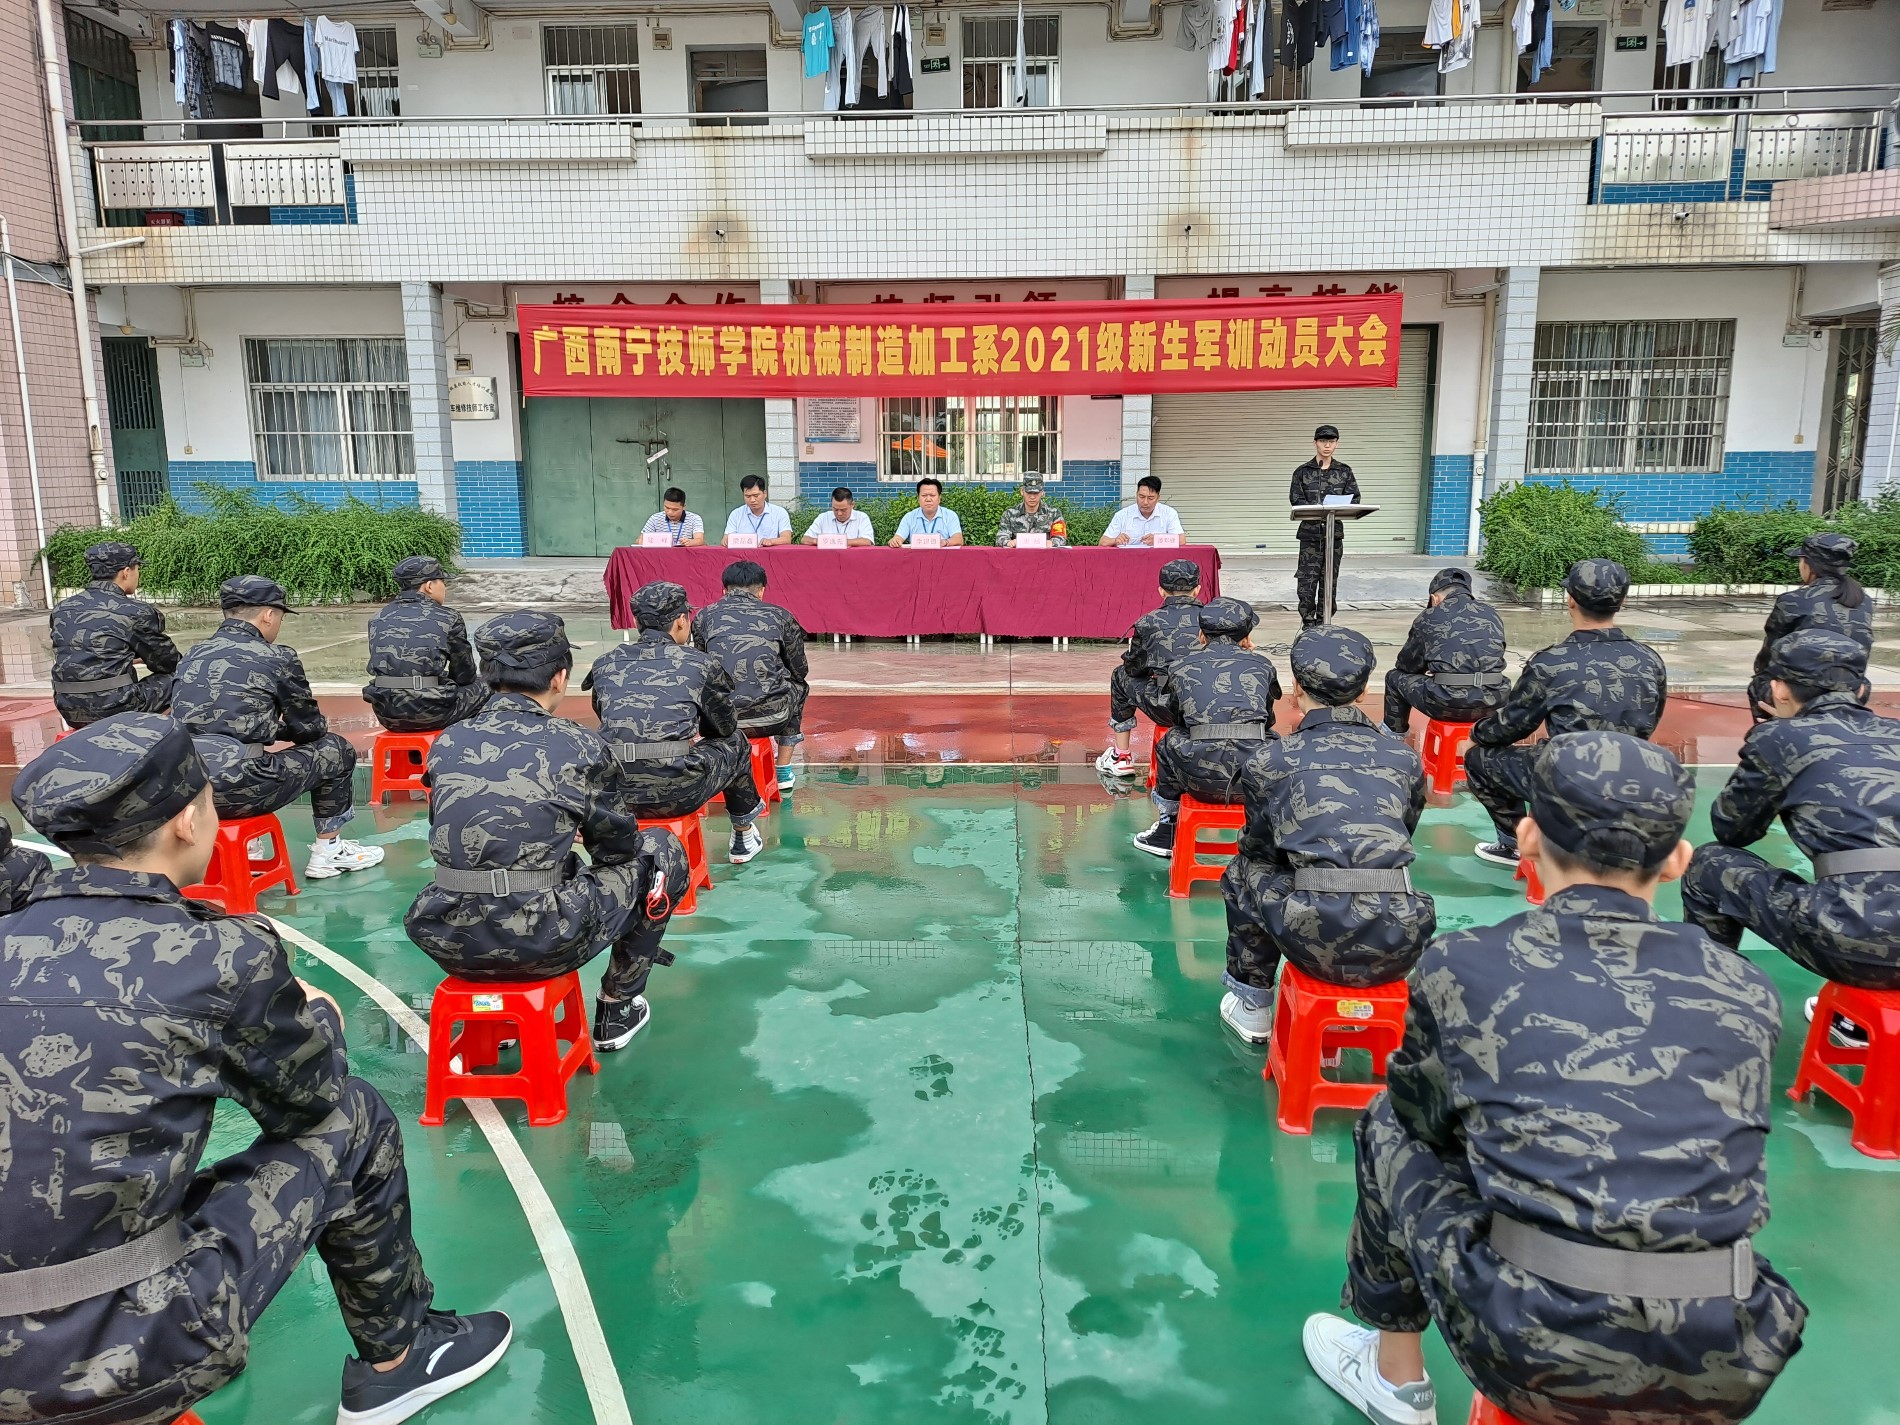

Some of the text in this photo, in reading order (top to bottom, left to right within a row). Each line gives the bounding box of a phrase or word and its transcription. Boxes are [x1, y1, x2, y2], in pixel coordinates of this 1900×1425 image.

[533, 314, 1388, 376] 广西南宁技师学院机械制造加工系2021级新生军训动员大会
